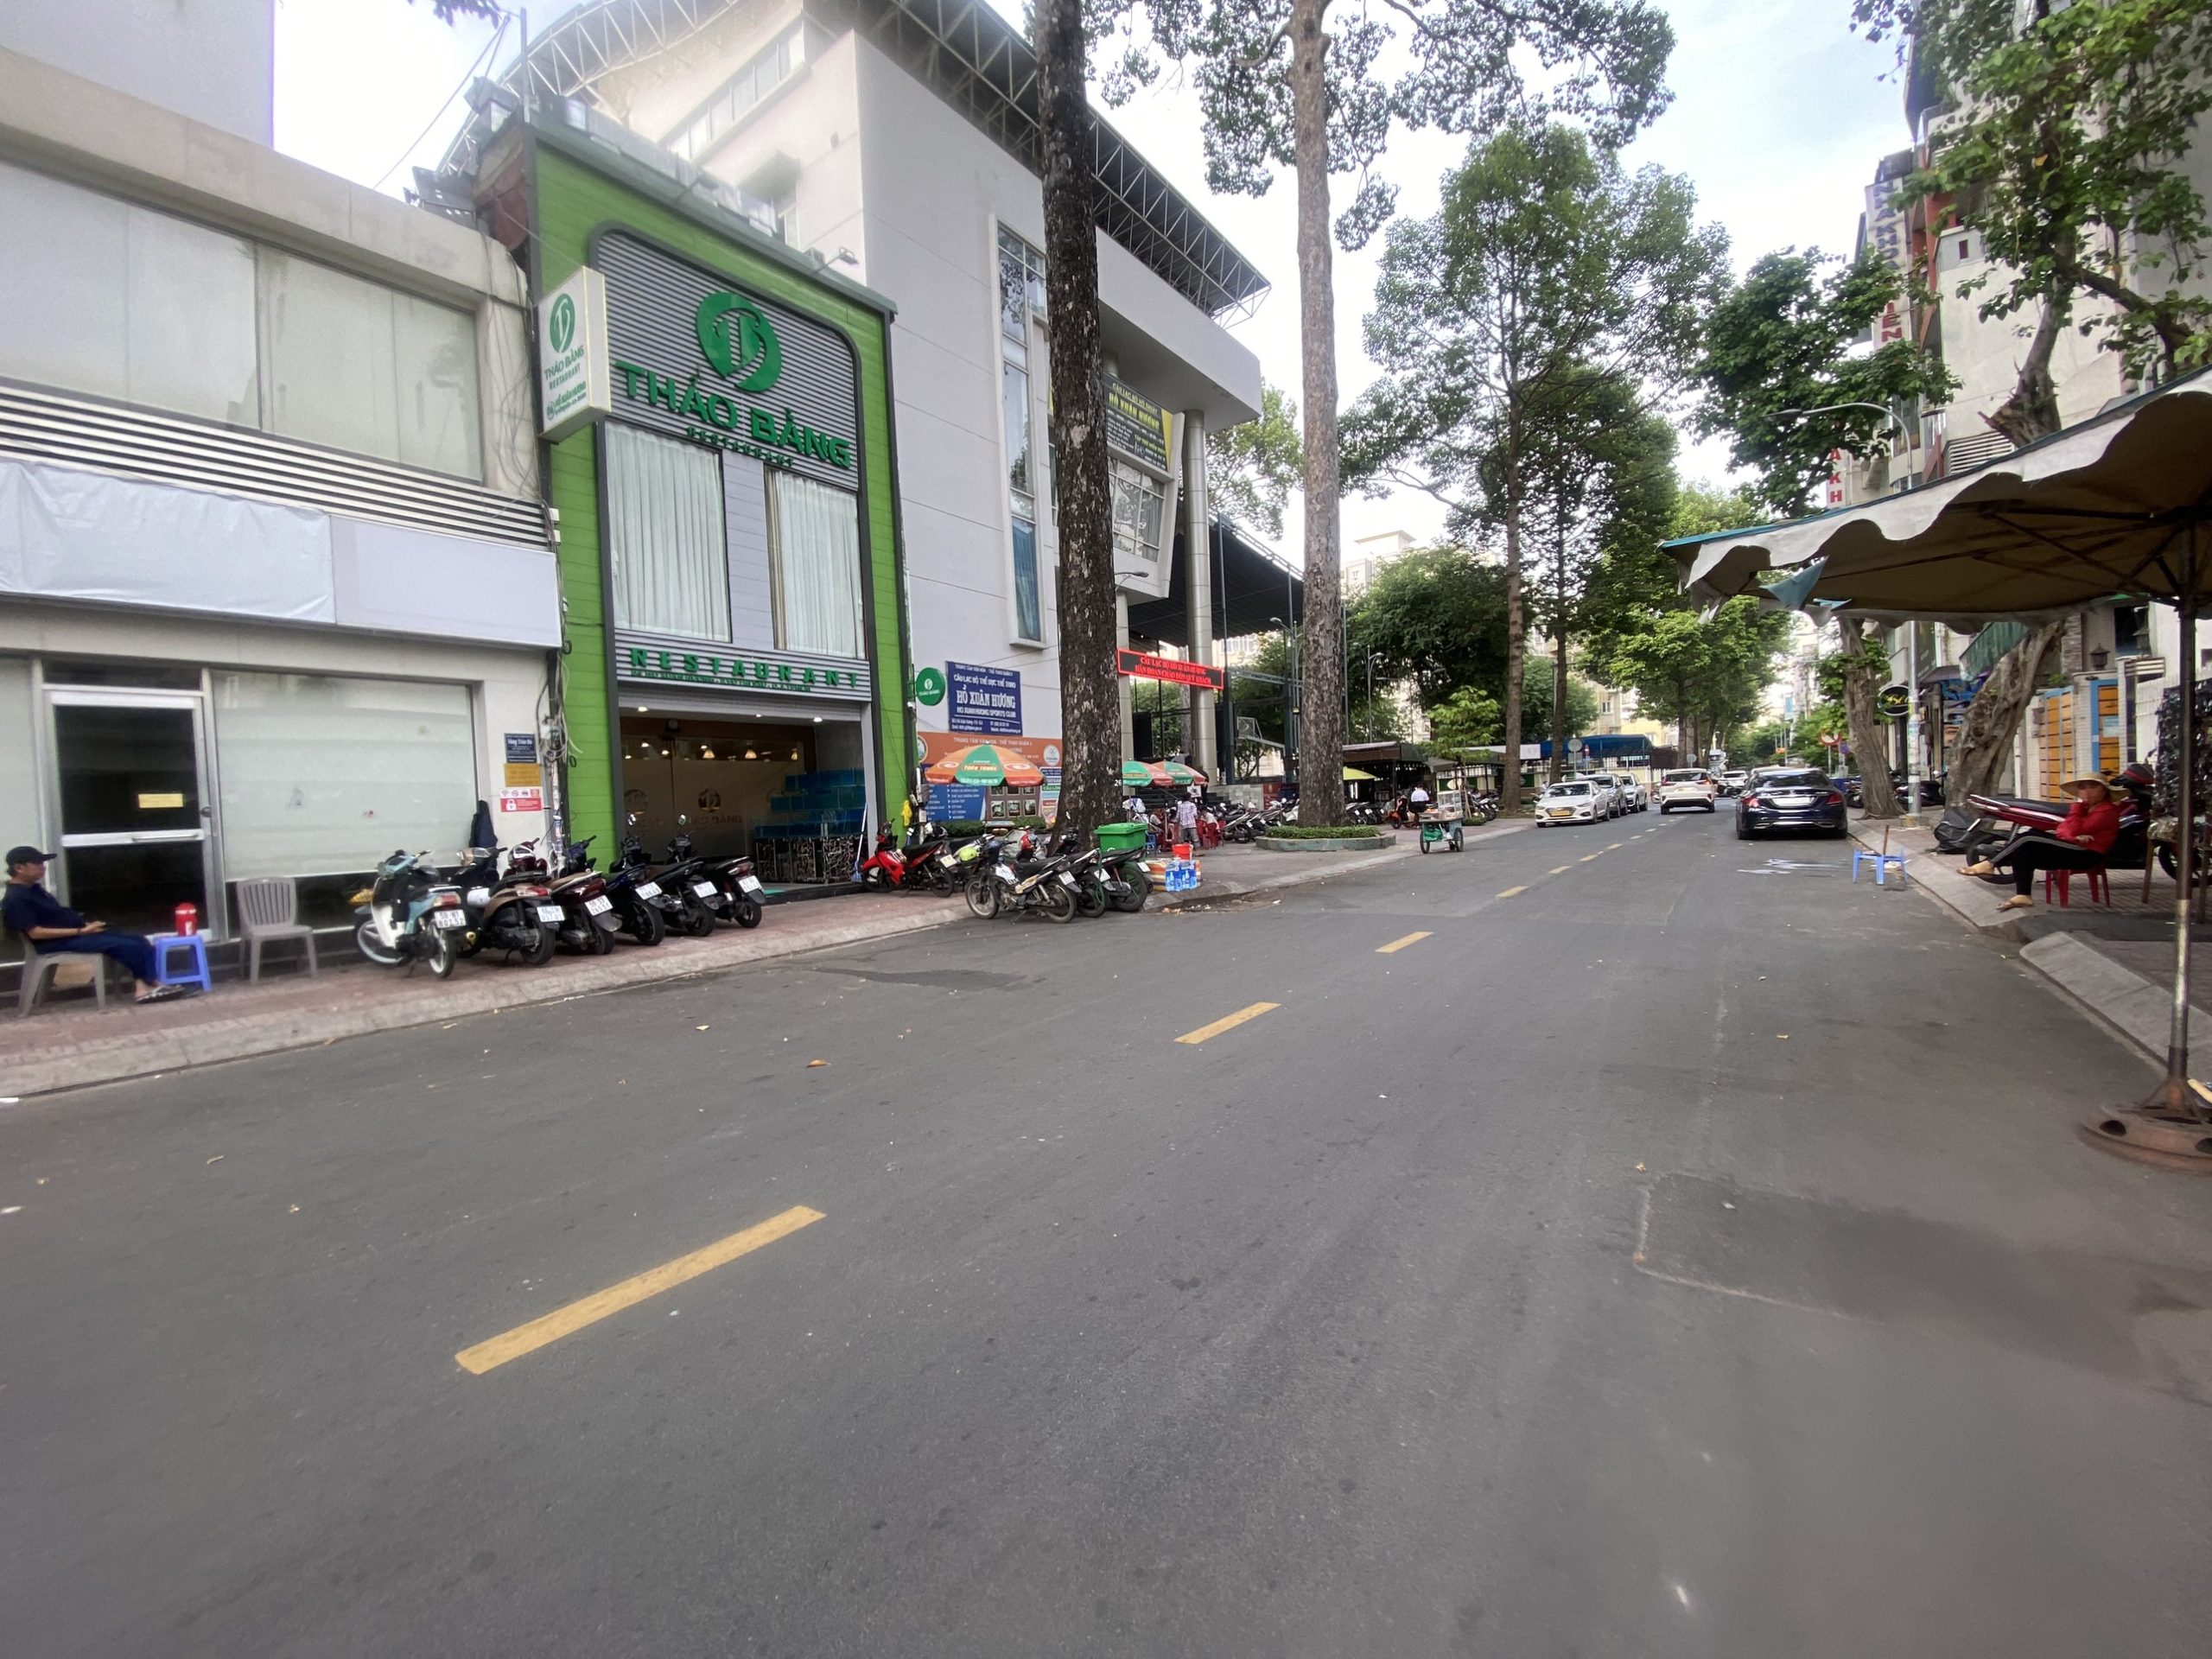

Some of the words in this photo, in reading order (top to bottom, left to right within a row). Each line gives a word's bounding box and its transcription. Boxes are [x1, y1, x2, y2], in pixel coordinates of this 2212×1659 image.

[615, 359, 738, 429] THẢO
[751, 407, 852, 469] BẢNG
[685, 426, 794, 468] RESTAURANT
[630, 647, 858, 689] RESTAURANT
[963, 675, 972, 684] LẠC
[969, 689, 990, 706] XUÂN
[991, 692, 1016, 709] HƯƠNG
[1114, 779, 1122, 787] 26
